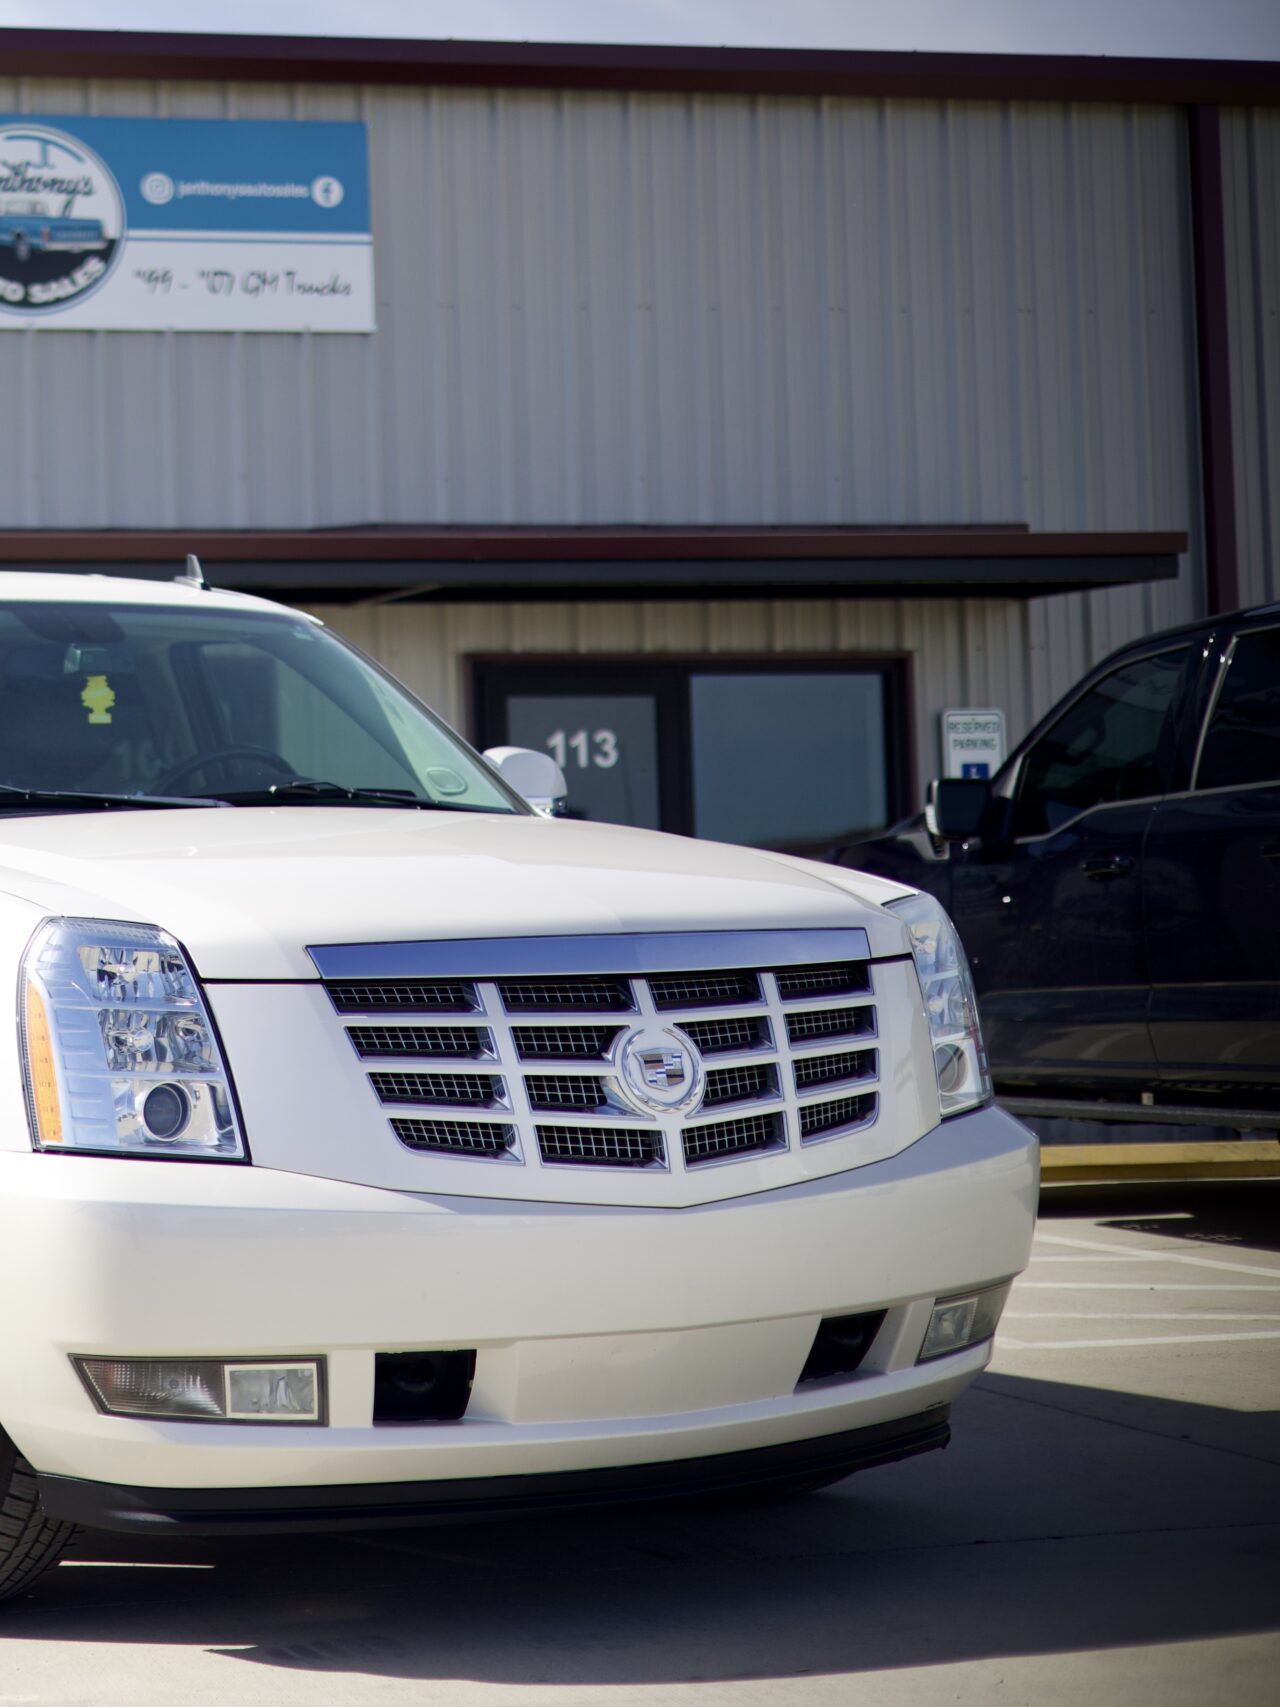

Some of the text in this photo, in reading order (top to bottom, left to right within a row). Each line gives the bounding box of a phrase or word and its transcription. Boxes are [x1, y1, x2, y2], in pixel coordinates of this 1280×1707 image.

[284, 269, 353, 297] Trucks
[947, 721, 1001, 735] RESERVED
[547, 729, 619, 769] 113
[952, 738, 998, 752] PARKING
